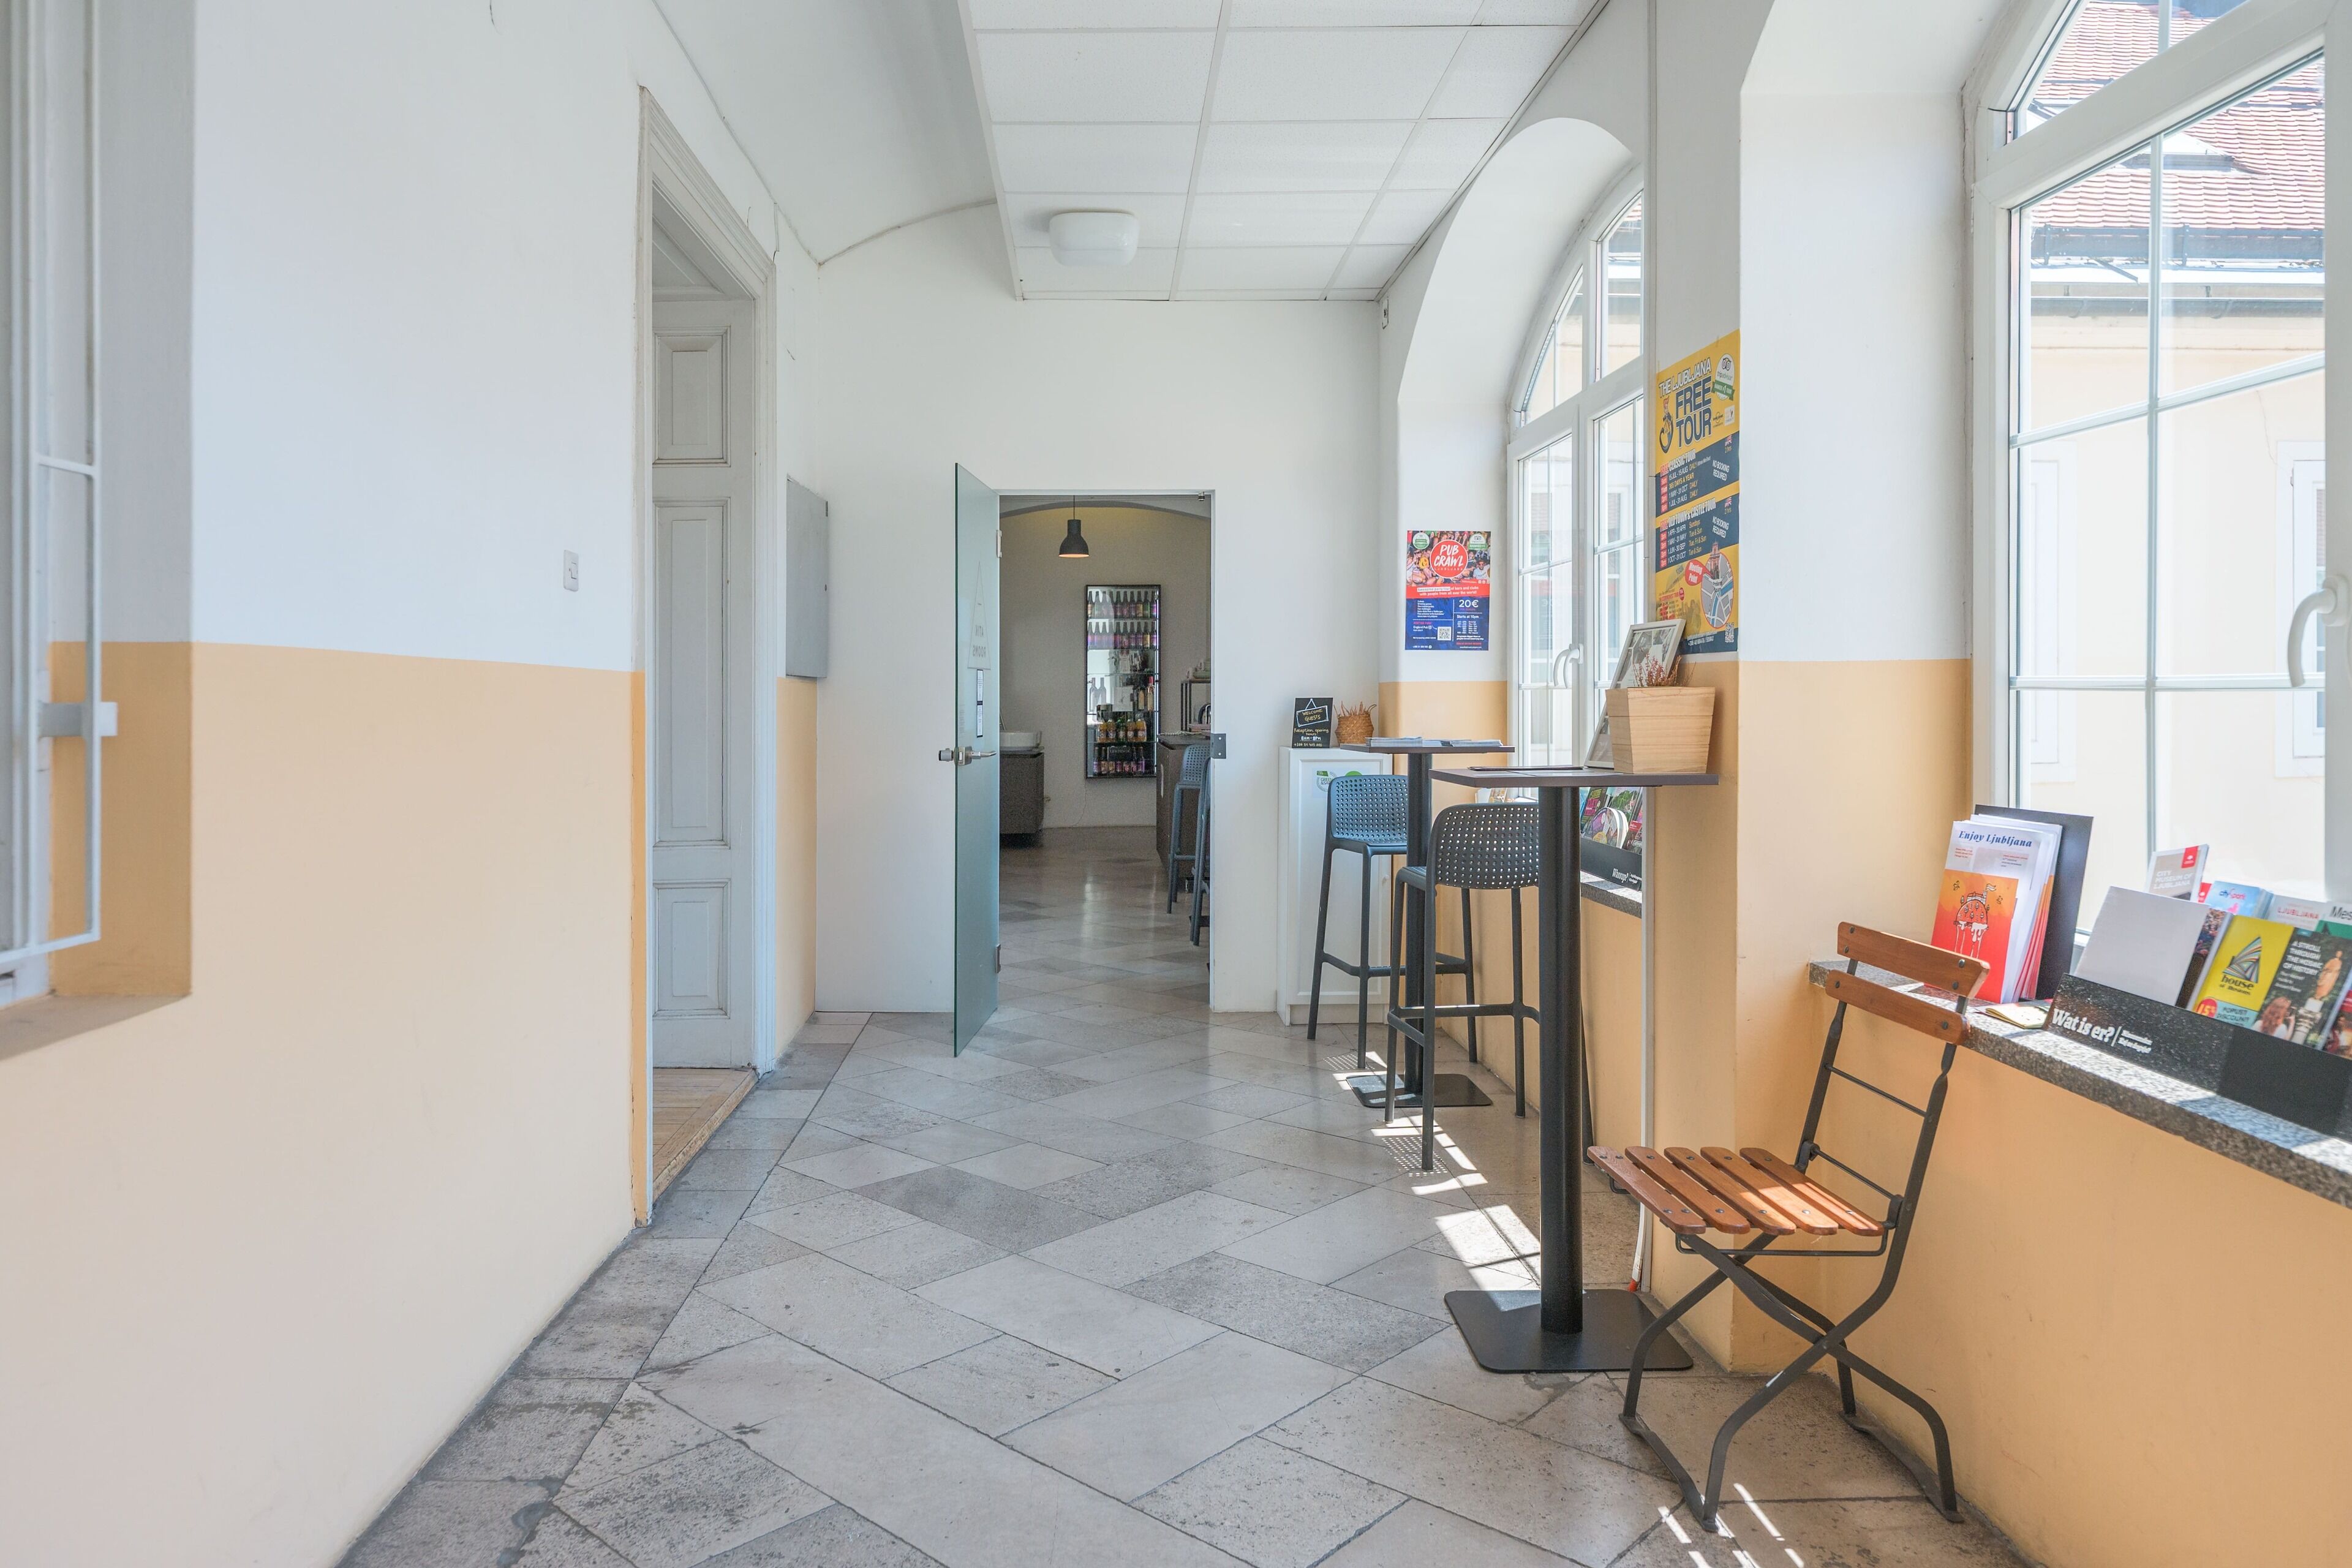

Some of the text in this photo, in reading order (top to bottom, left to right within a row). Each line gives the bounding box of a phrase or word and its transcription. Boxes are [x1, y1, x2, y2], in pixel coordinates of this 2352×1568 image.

[1659, 357, 1711, 398] THE LJUBLJANA
[1676, 375, 1711, 420] FREE
[1676, 407, 1711, 448] TOUR
[1669, 454, 1685, 472] CLASSIC
[1685, 449, 1696, 463] TOUR
[1717, 461, 1730, 473] BOOKING
[1675, 478, 1683, 488] DAYS
[1686, 472, 1694, 482] YEAR
[1713, 469, 1727, 481] REQUIRED
[1689, 480, 1698, 489] DAILY
[1689, 489, 1698, 498] DAILY
[1676, 510, 1687, 524] TOWN
[1691, 503, 1705, 519] CASTLE
[1705, 498, 1716, 513] TOUR
[1716, 518, 1729, 530] BOOKING
[1712, 526, 1726, 538] REQUIRED
[1440, 545, 1459, 556] PUB
[1434, 556, 1464, 567] CRAWL
[1689, 562, 1703, 575] Meeting
[1689, 573, 1698, 584] Point
[1958, 831, 2032, 847] Enjoy Ljubljana
[2153, 880, 2191, 889] LJUBLJANA
[2155, 874, 2183, 883] MUSEUM
[2277, 907, 2320, 919] LJUBLJANA
[2297, 942, 2321, 952] STROLL
[2290, 948, 2321, 960] THROUGH
[2299, 959, 2324, 969] MOSAIC
[2292, 965, 2319, 976] HISTORY
[2221, 974, 2255, 990] house
[2052, 1008, 2079, 1031] Wat
[2076, 1017, 2093, 1036] is
[2090, 1026, 2116, 1042] er?
